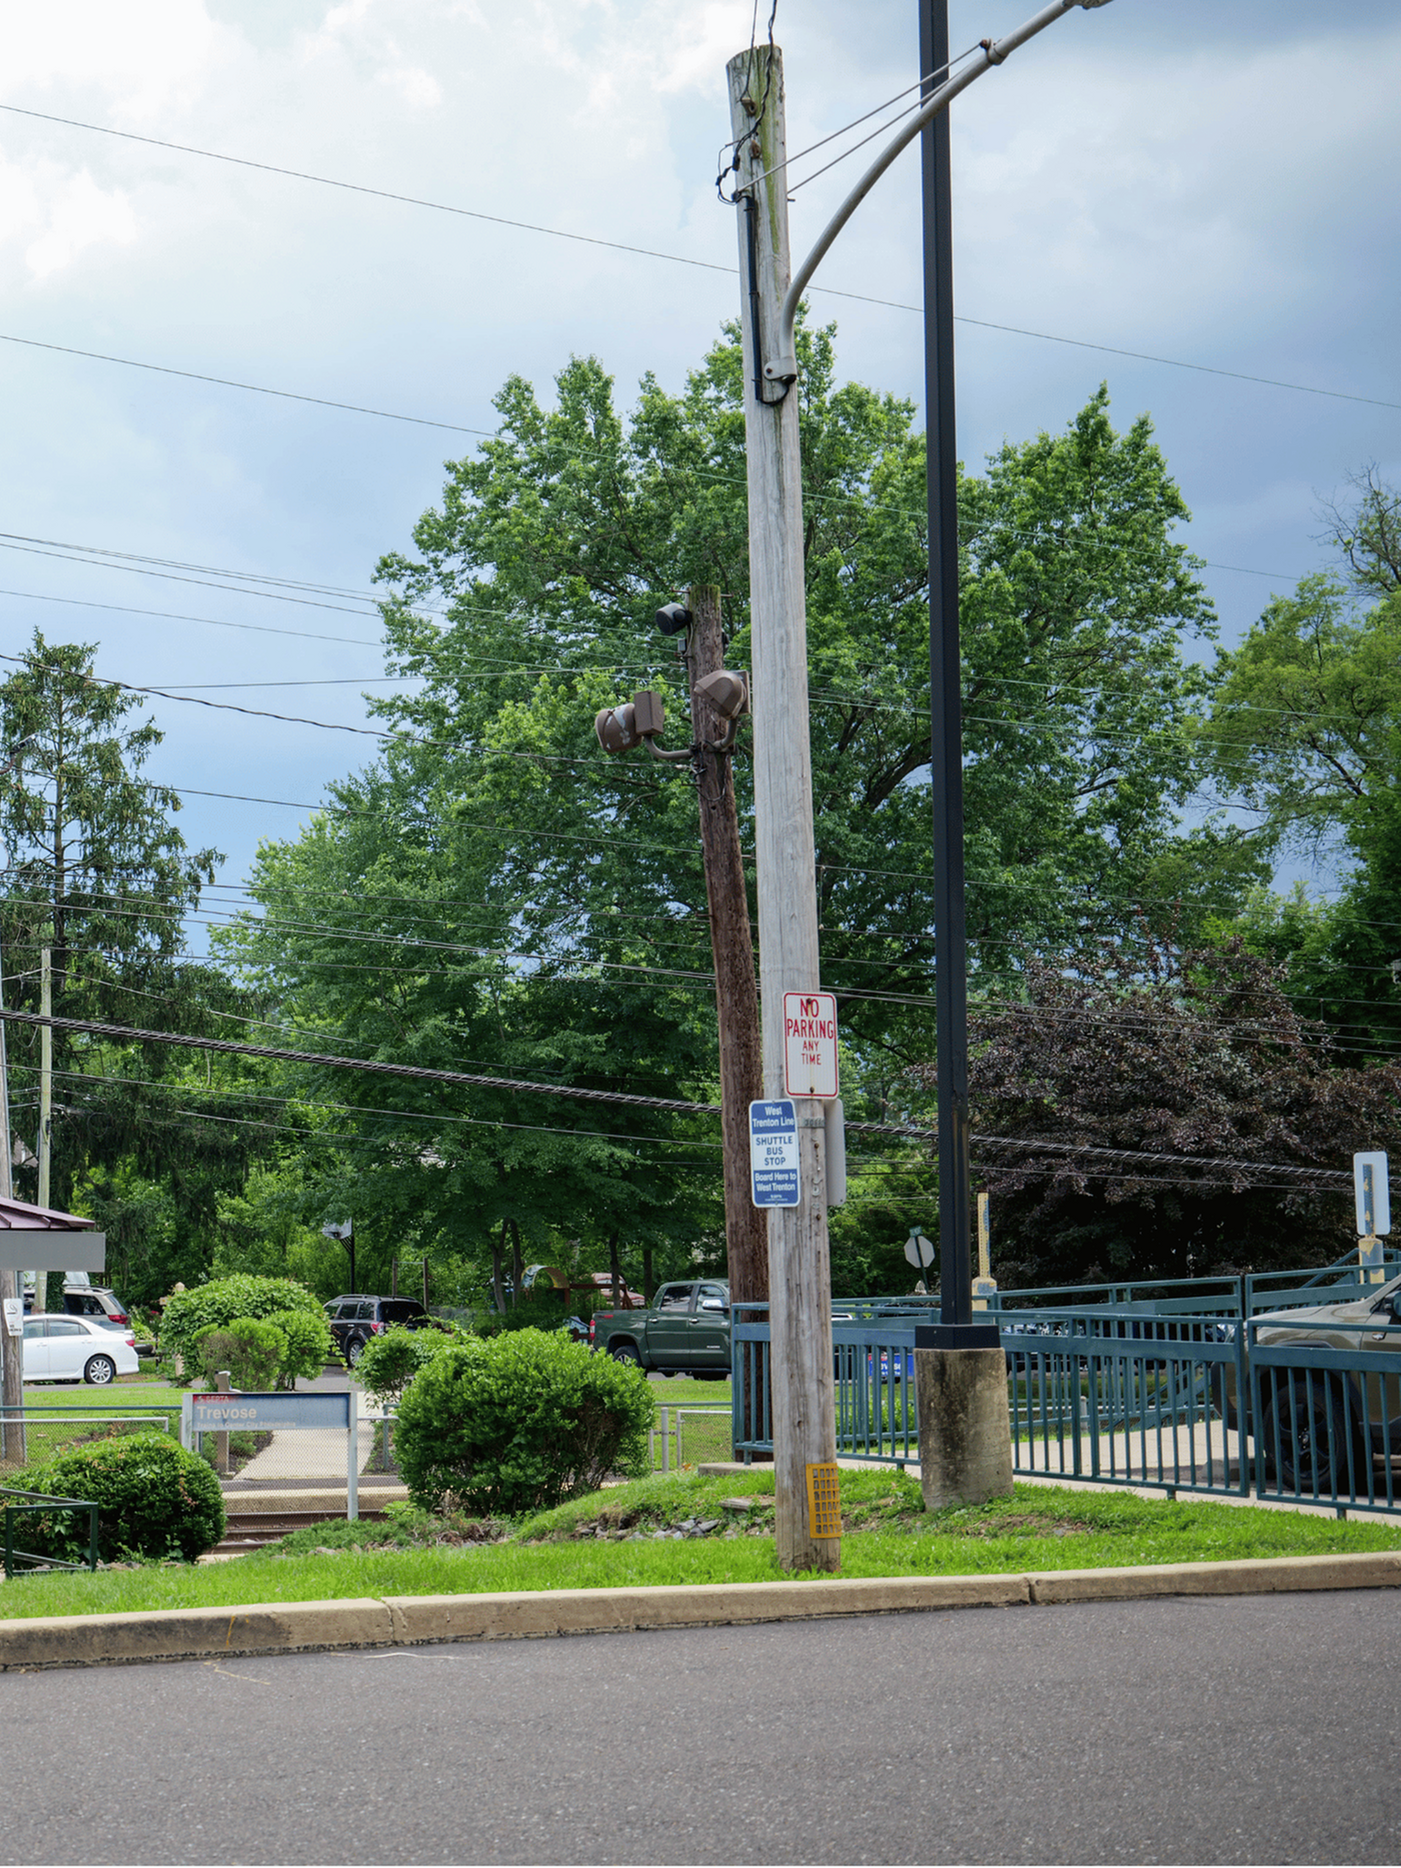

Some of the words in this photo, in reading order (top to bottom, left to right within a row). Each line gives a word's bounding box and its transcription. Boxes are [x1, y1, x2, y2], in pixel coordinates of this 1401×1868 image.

[800, 998, 819, 1018] NO
[787, 1018, 834, 1039] PARKING
[803, 1040, 819, 1051] ANY
[801, 1053, 821, 1065] TIME
[764, 1106, 782, 1116] West
[752, 1118, 779, 1128] Trenton
[780, 1116, 795, 1126] Line
[756, 1136, 793, 1146] SHUTTLE
[766, 1146, 783, 1155] BUS
[764, 1157, 786, 1166] STOP
[755, 1172, 773, 1181] Board
[774, 1172, 789, 1181] Here
[789, 1172, 797, 1180] to
[756, 1183, 772, 1191] West
[772, 1182, 795, 1191] Trenton
[197, 1406, 257, 1419] Trevose
